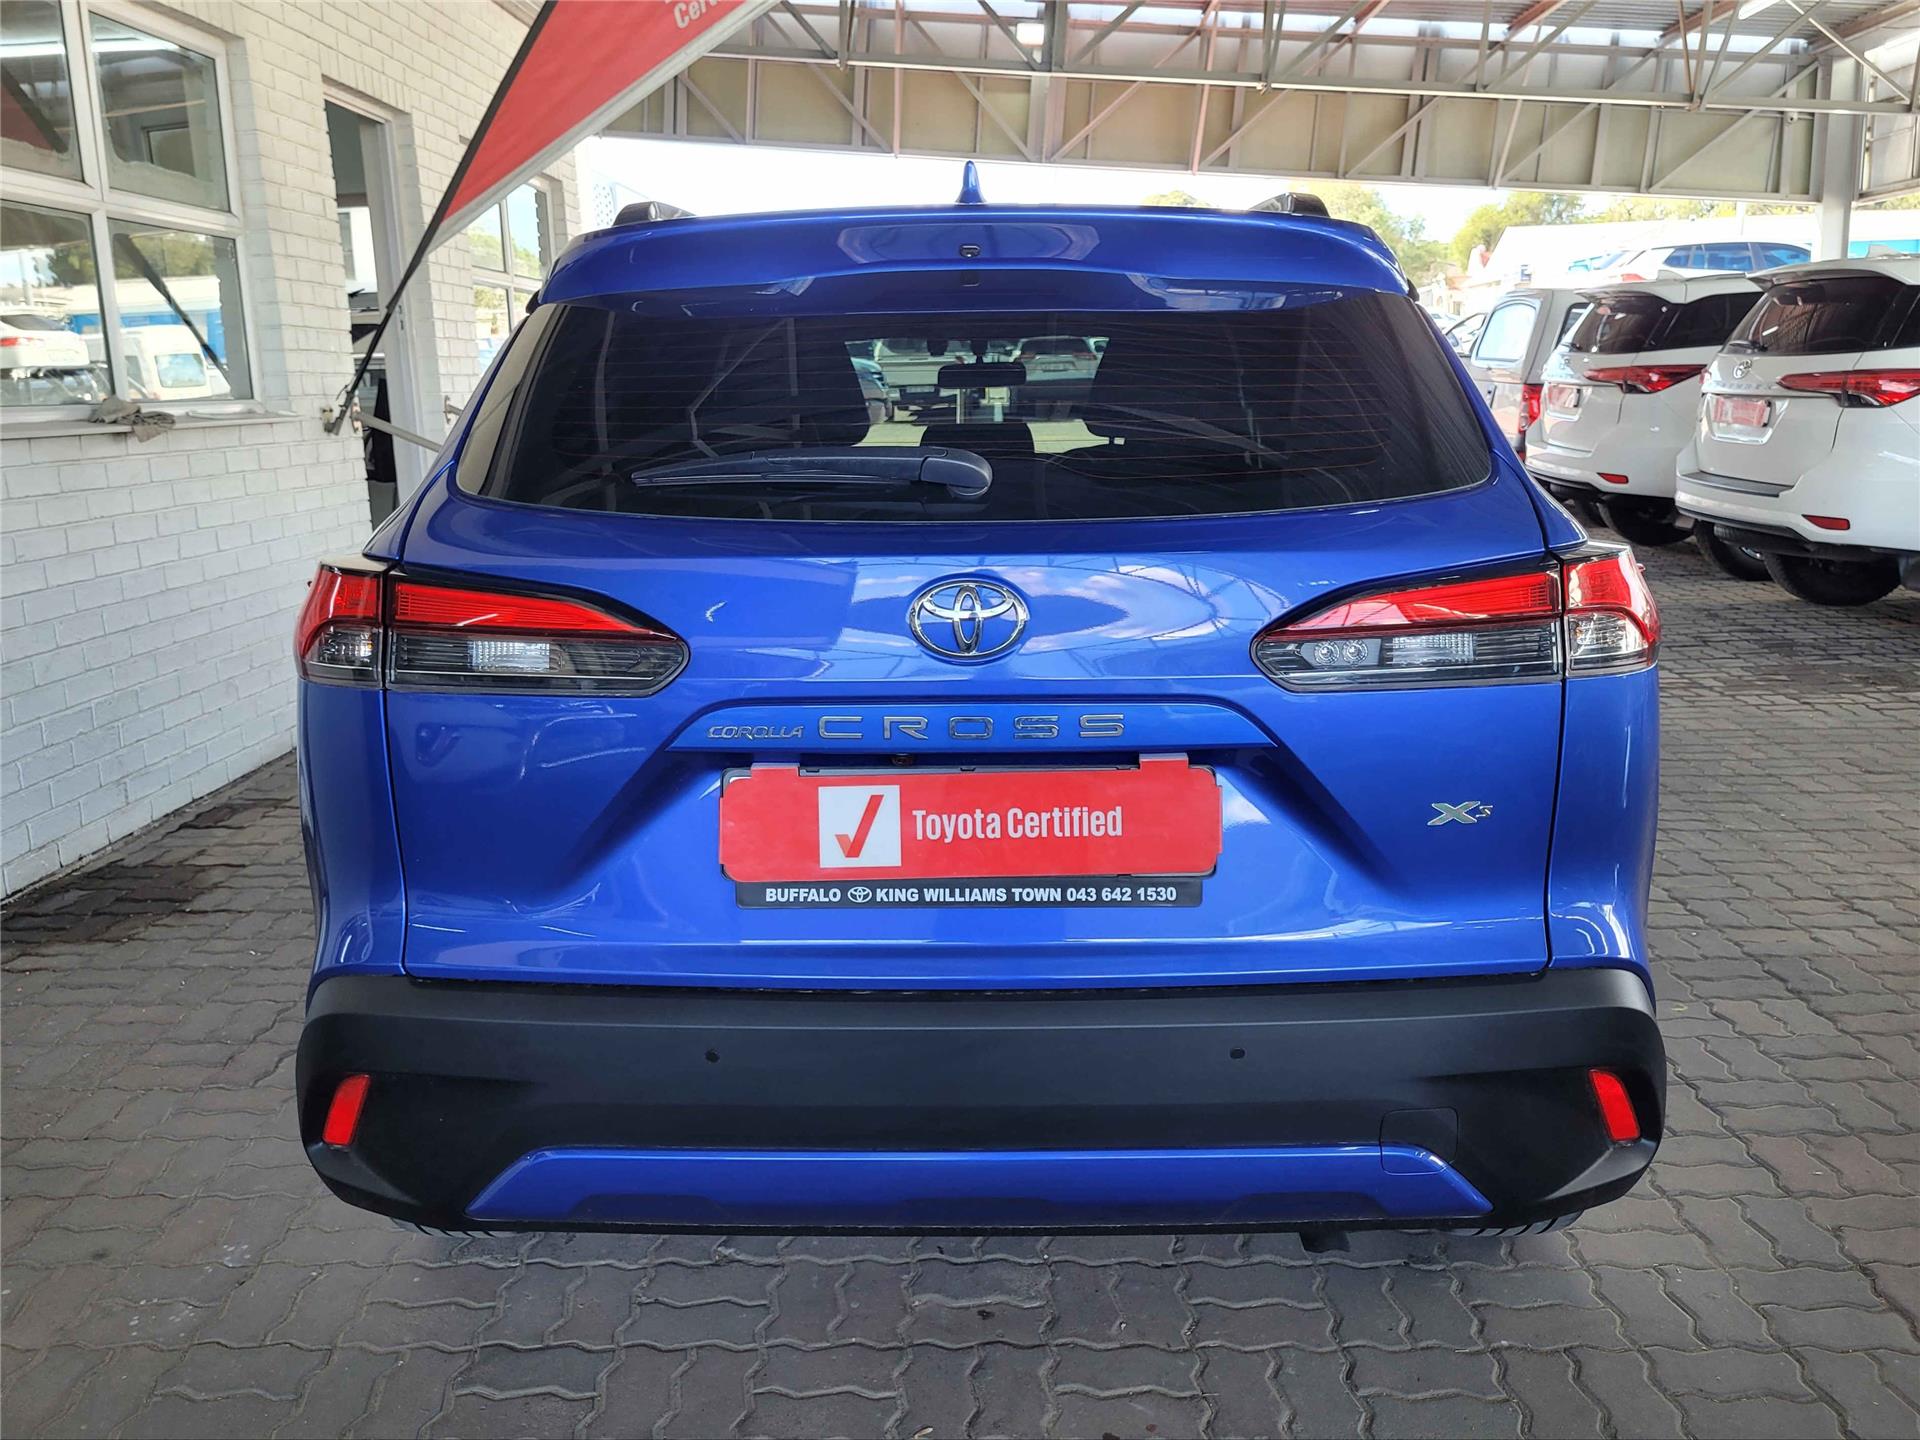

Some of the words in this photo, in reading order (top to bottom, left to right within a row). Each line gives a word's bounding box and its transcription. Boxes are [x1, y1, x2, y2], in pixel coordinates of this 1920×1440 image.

[707, 725, 804, 740] COROLLA
[818, 713, 1125, 740] CROSS
[911, 807, 1001, 843] Toyota
[1006, 805, 1123, 839] Certified
[765, 888, 841, 902] BUFFALO
[876, 888, 919, 902] KING
[923, 888, 1008, 902] WILLIAMS
[1011, 887, 1062, 902] TOWN
[1066, 887, 1097, 902] 043
[1101, 887, 1132, 901] 642
[1136, 886, 1177, 901] 1530
